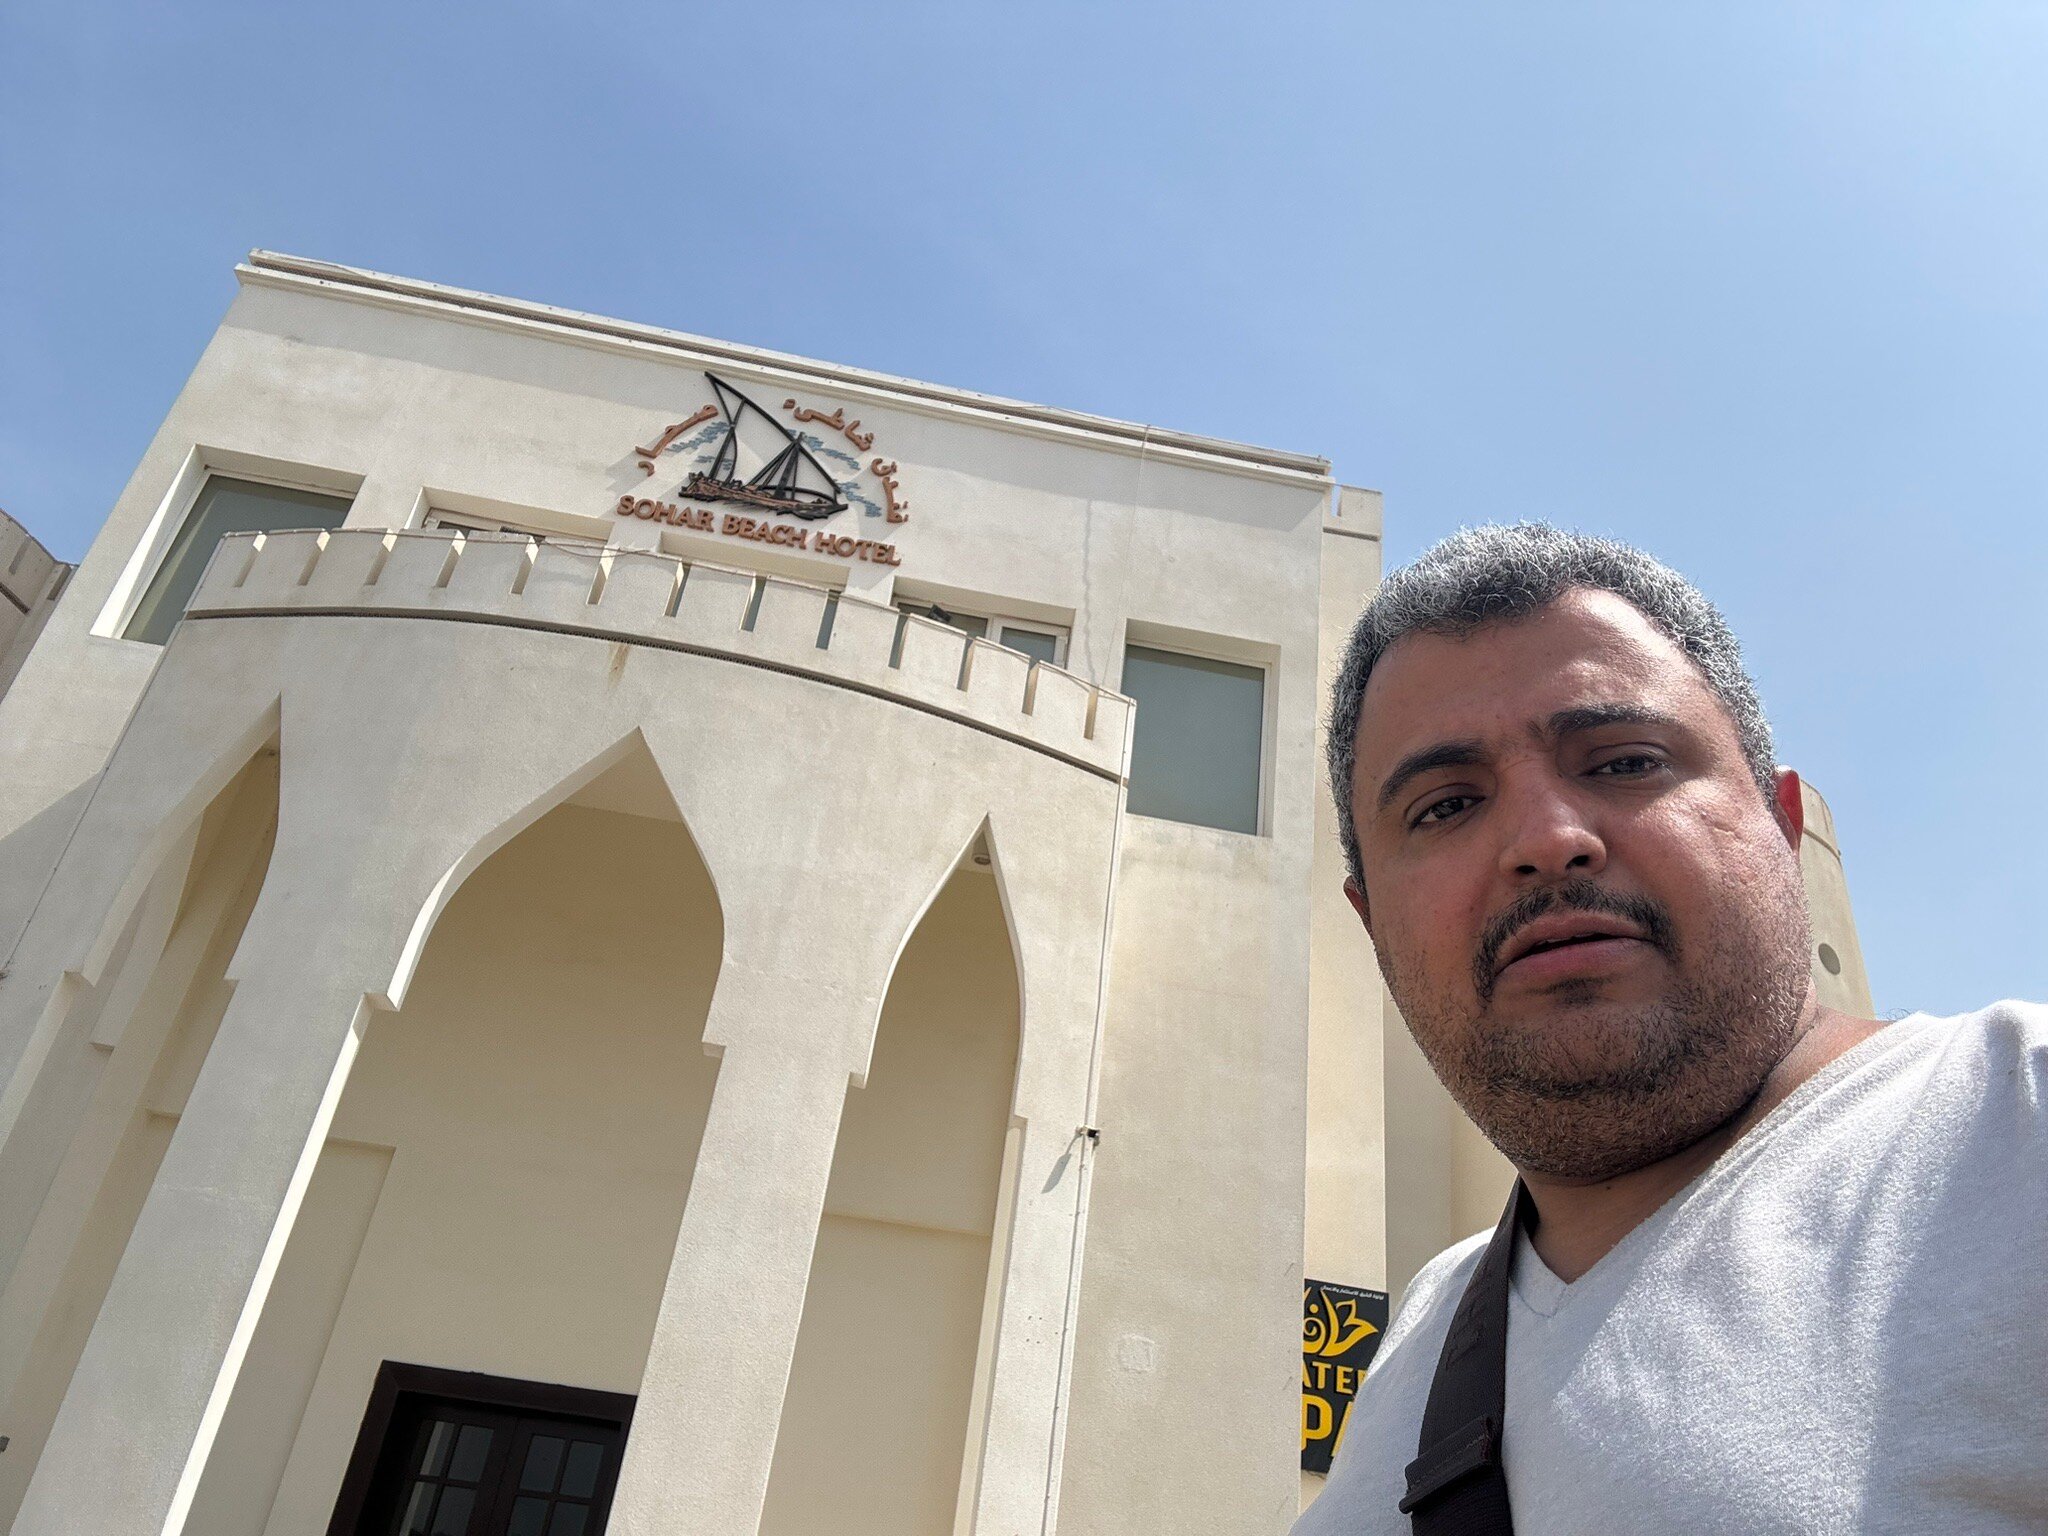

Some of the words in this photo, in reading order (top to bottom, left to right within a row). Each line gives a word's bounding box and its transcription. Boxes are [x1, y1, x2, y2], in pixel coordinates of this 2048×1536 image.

[870, 457, 909, 524] فندق
[616, 494, 715, 533] SOHAR
[721, 513, 808, 551] BEACH
[814, 530, 902, 567] HOTEL
